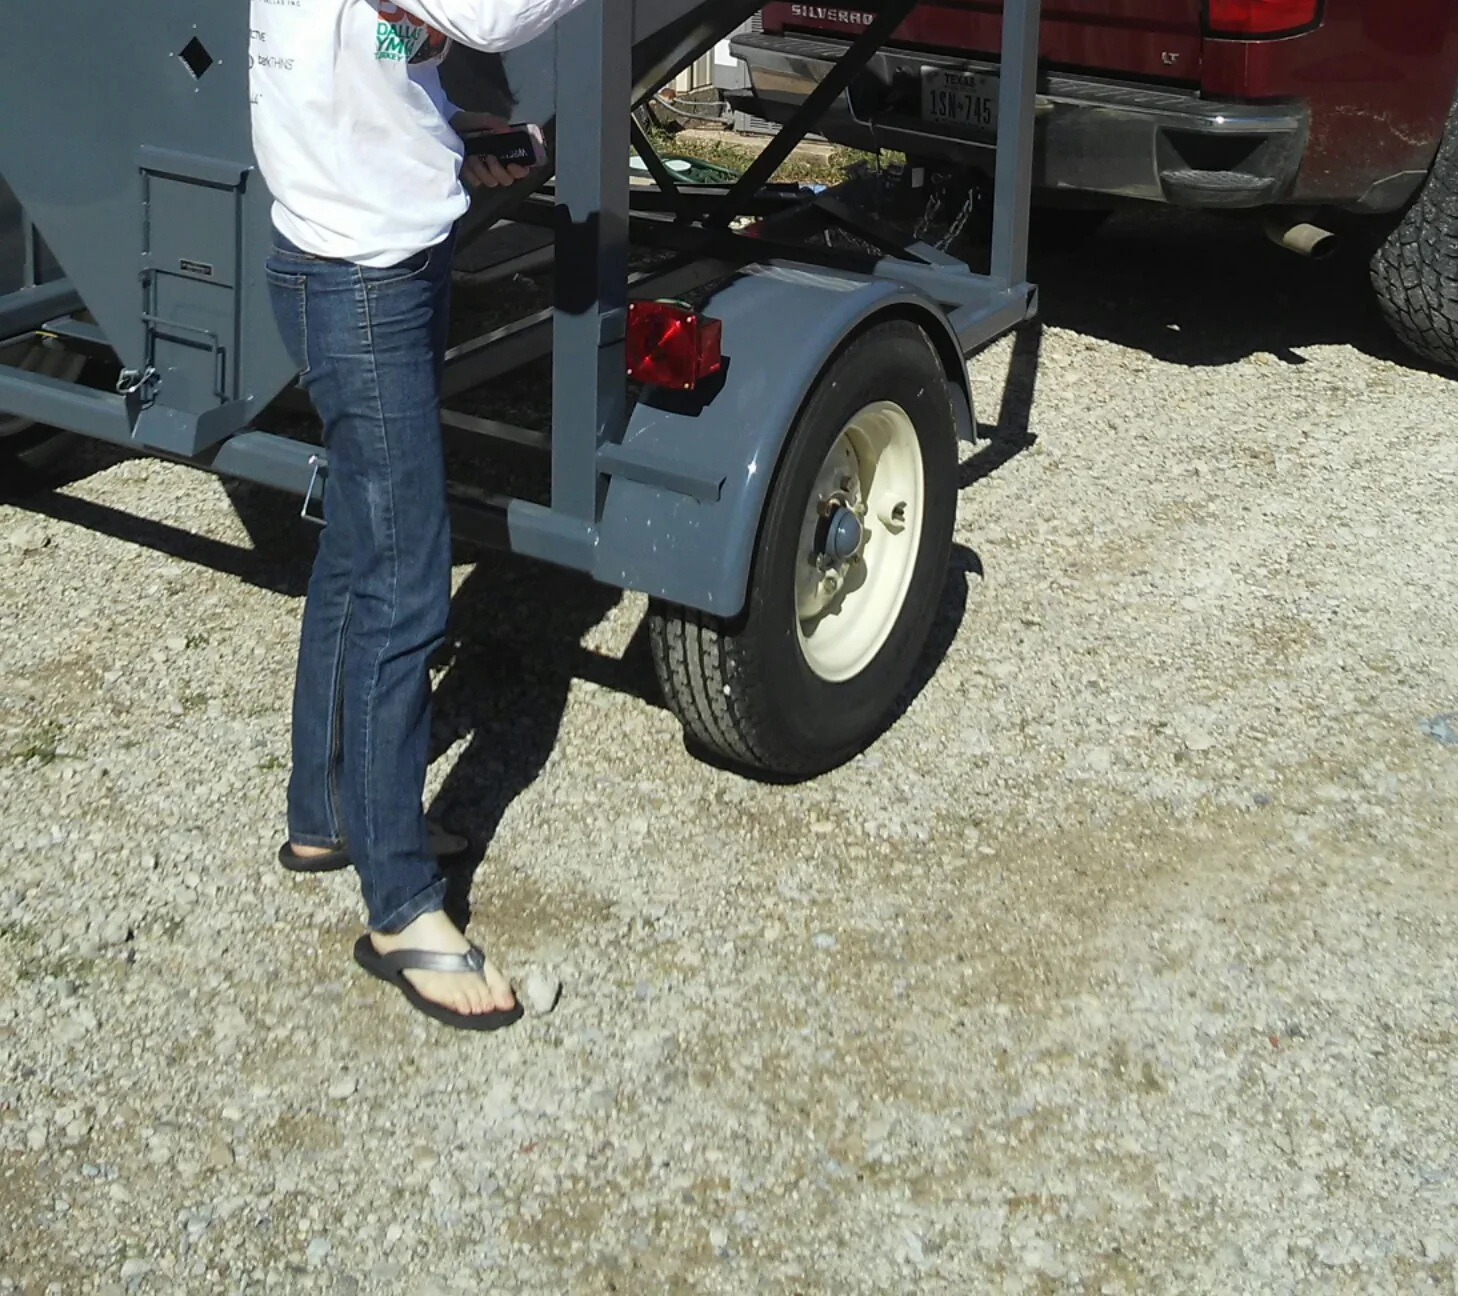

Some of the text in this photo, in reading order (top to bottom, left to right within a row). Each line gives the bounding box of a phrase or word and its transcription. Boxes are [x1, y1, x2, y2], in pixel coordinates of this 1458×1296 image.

[791, 4, 875, 26] SILVERAD
[1161, 51, 1179, 65] LT
[944, 71, 976, 87] TEXAS
